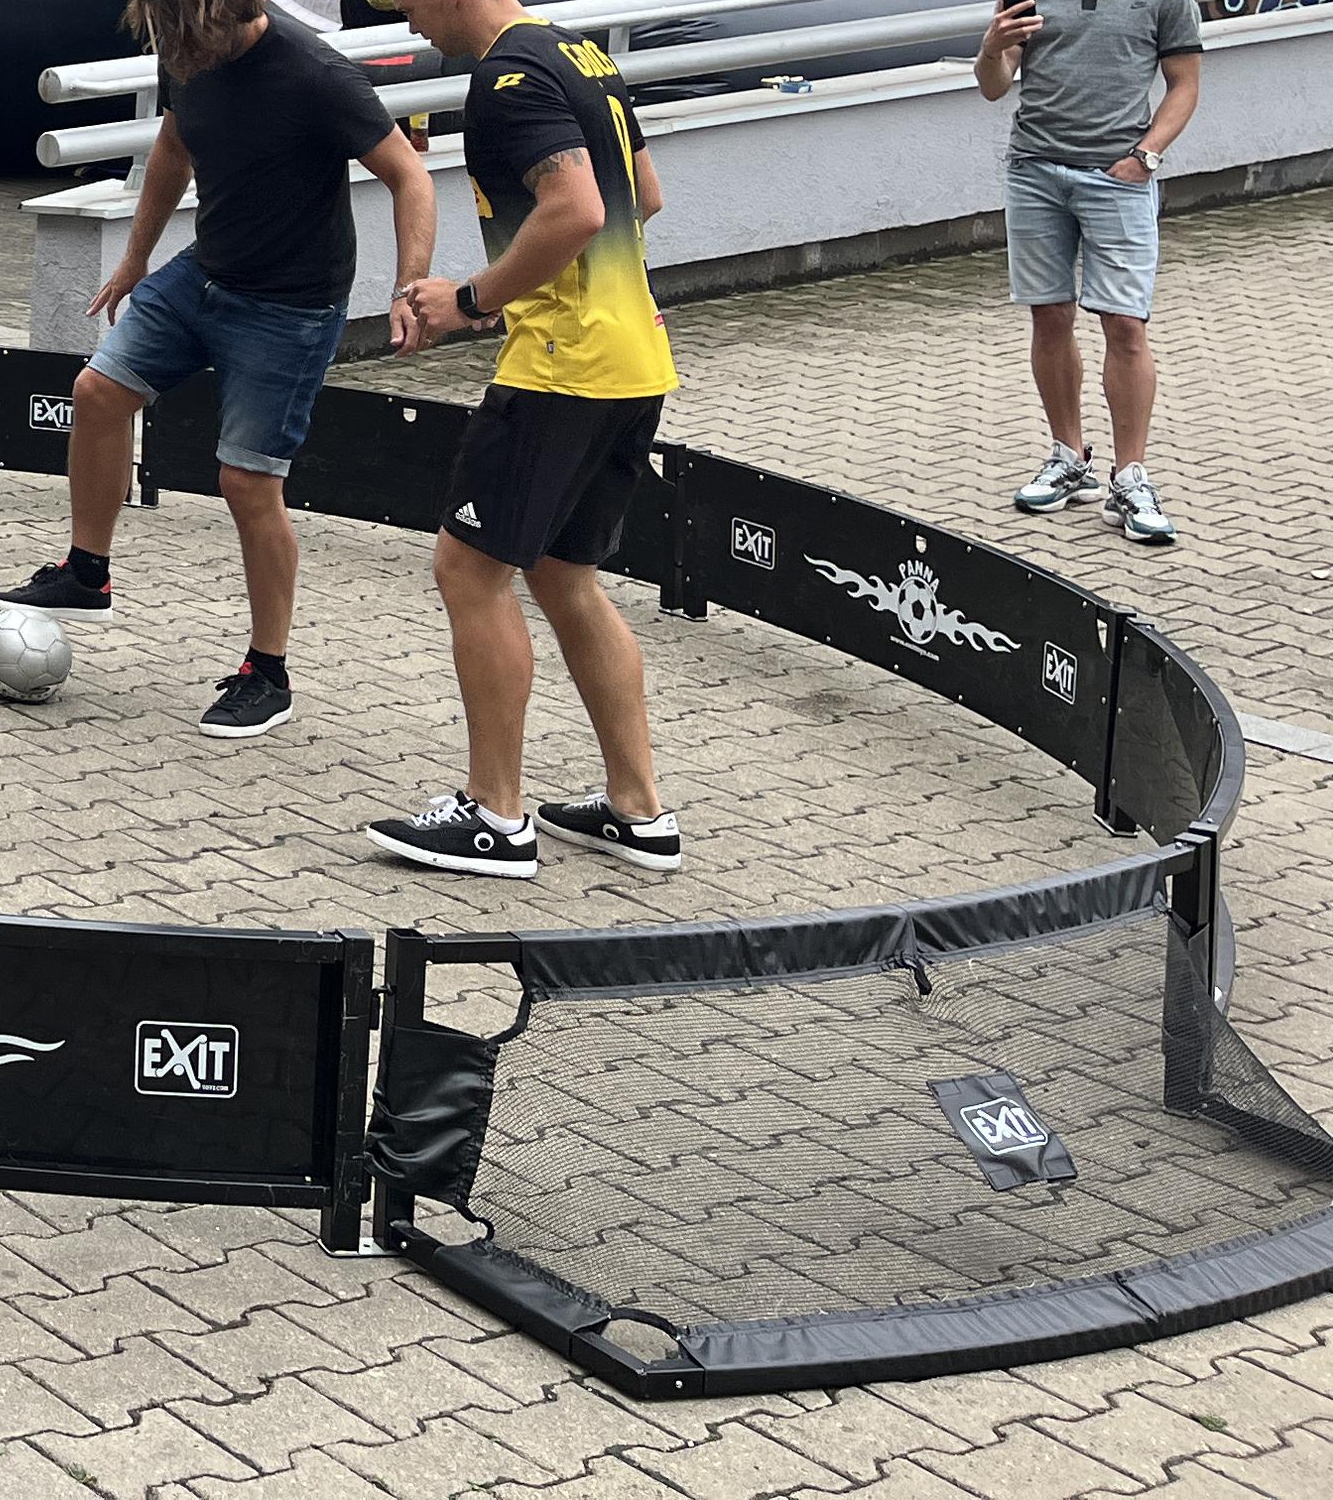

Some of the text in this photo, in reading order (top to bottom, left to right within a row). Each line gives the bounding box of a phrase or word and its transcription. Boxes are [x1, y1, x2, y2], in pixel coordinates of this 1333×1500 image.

[34, 398, 74, 428] EXIT
[735, 524, 772, 562] EXIT
[898, 560, 940, 594] PANNA
[1046, 649, 1074, 694] EXIT
[143, 1029, 230, 1090] EXIT
[971, 1104, 1044, 1145] EXIT
